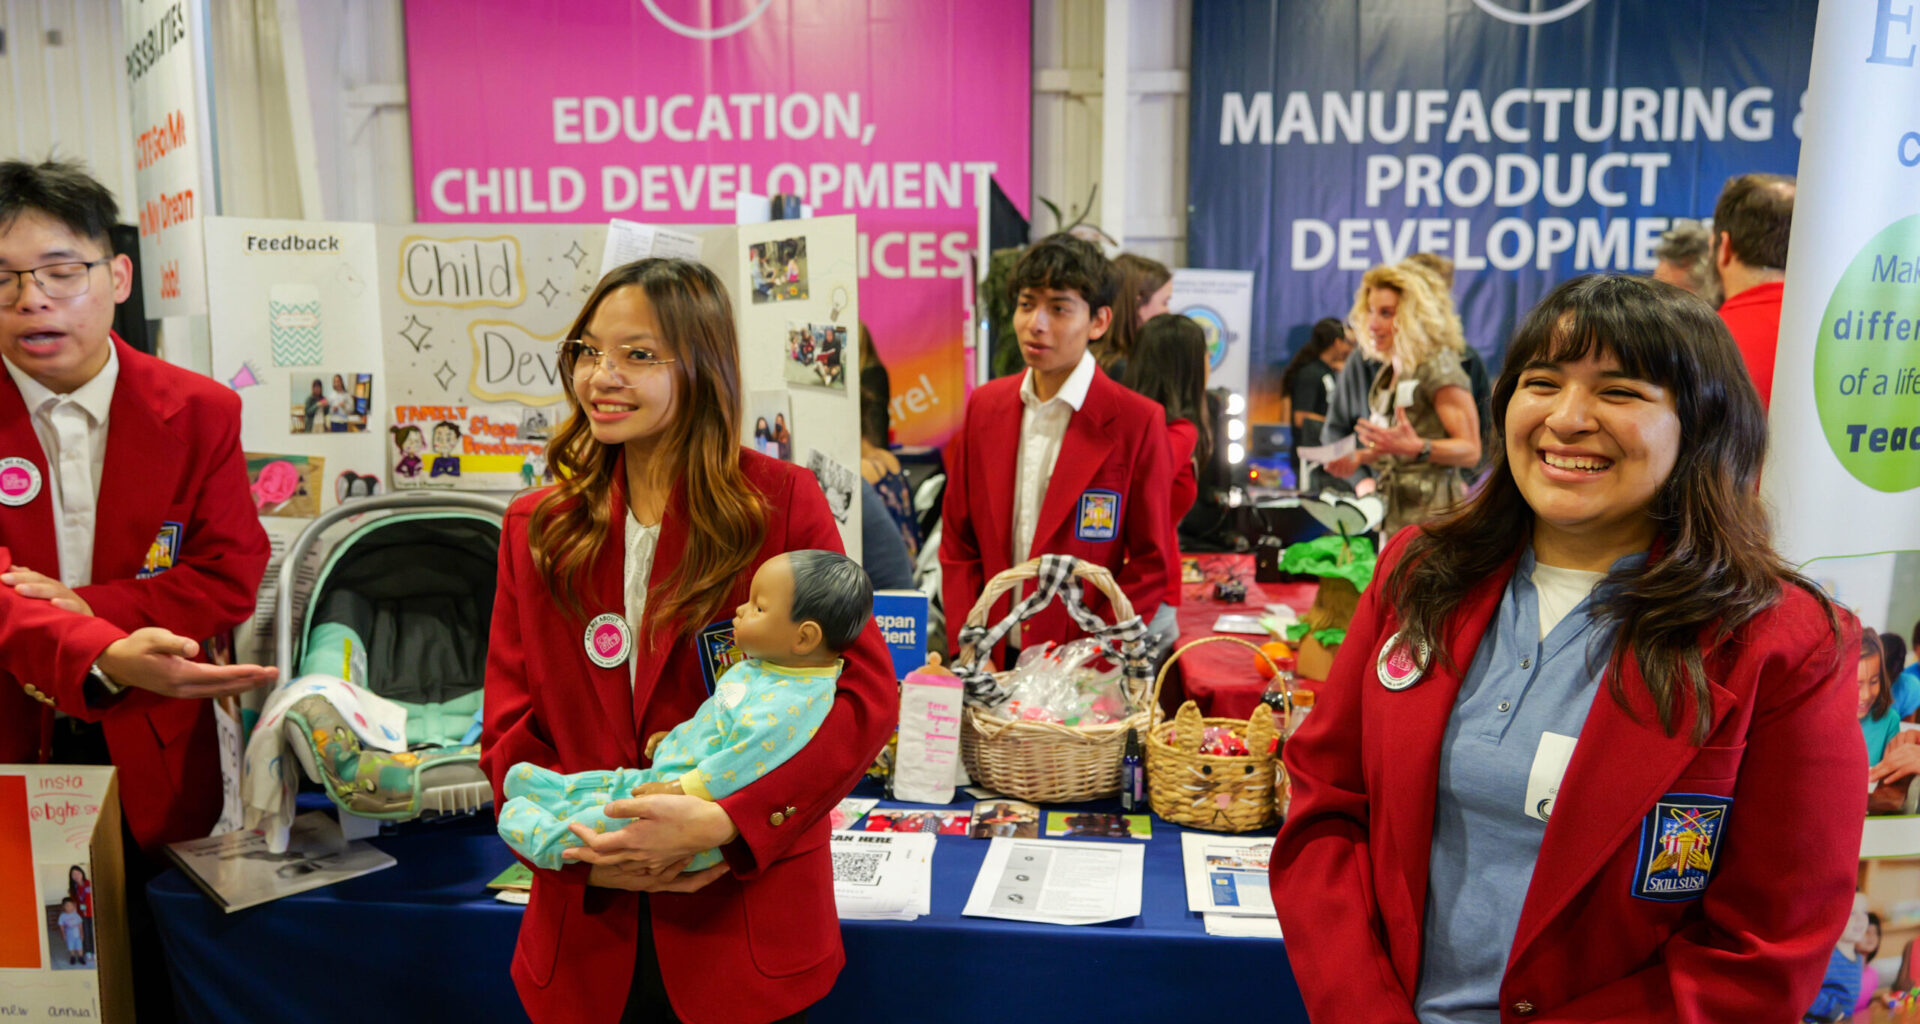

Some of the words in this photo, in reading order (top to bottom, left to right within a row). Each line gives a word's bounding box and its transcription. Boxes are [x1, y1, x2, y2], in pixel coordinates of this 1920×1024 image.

[553, 93, 877, 146] EDUCATION,
[1220, 87, 1775, 145] MANUFACTURING
[431, 167, 587, 214] CHILD
[1365, 153, 1671, 208] PRODUCT
[247, 235, 340, 251] Feedback
[1291, 217, 1715, 272] DEVELOPME
[407, 243, 512, 297] Child
[484, 330, 561, 387] Dev
[1839, 367, 1869, 395] of
[1872, 374, 1888, 395] a
[395, 405, 469, 424] FAMILY
[888, 373, 940, 427] re!
[599, 615, 619, 623] ABOUT
[875, 615, 915, 631] span
[858, 836, 893, 844] HERE
